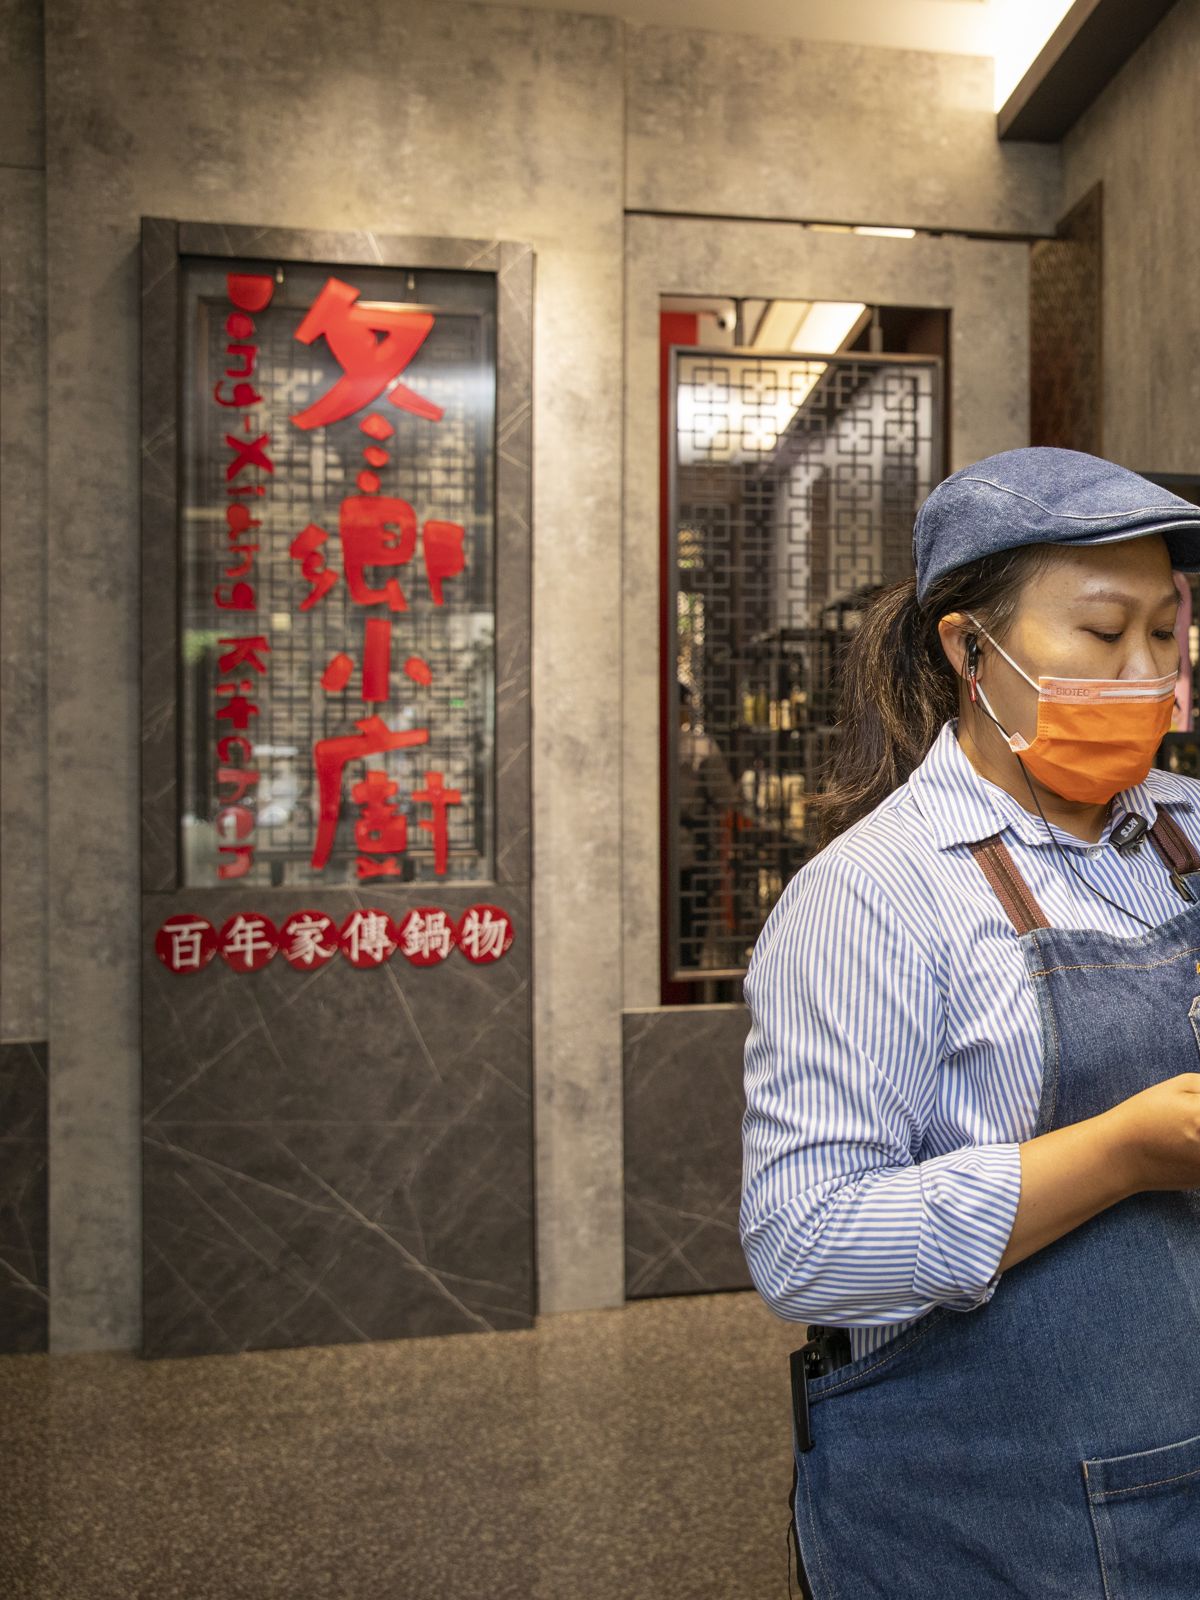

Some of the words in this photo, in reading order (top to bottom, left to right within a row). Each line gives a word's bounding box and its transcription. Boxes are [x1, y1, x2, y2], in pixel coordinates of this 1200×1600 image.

[214, 272, 275, 612] Dong-Xiang
[290, 276, 467, 877] 冬鄉小廚
[215, 634, 273, 880] Kitchen
[163, 909, 508, 969] 百年家傳鍋物
